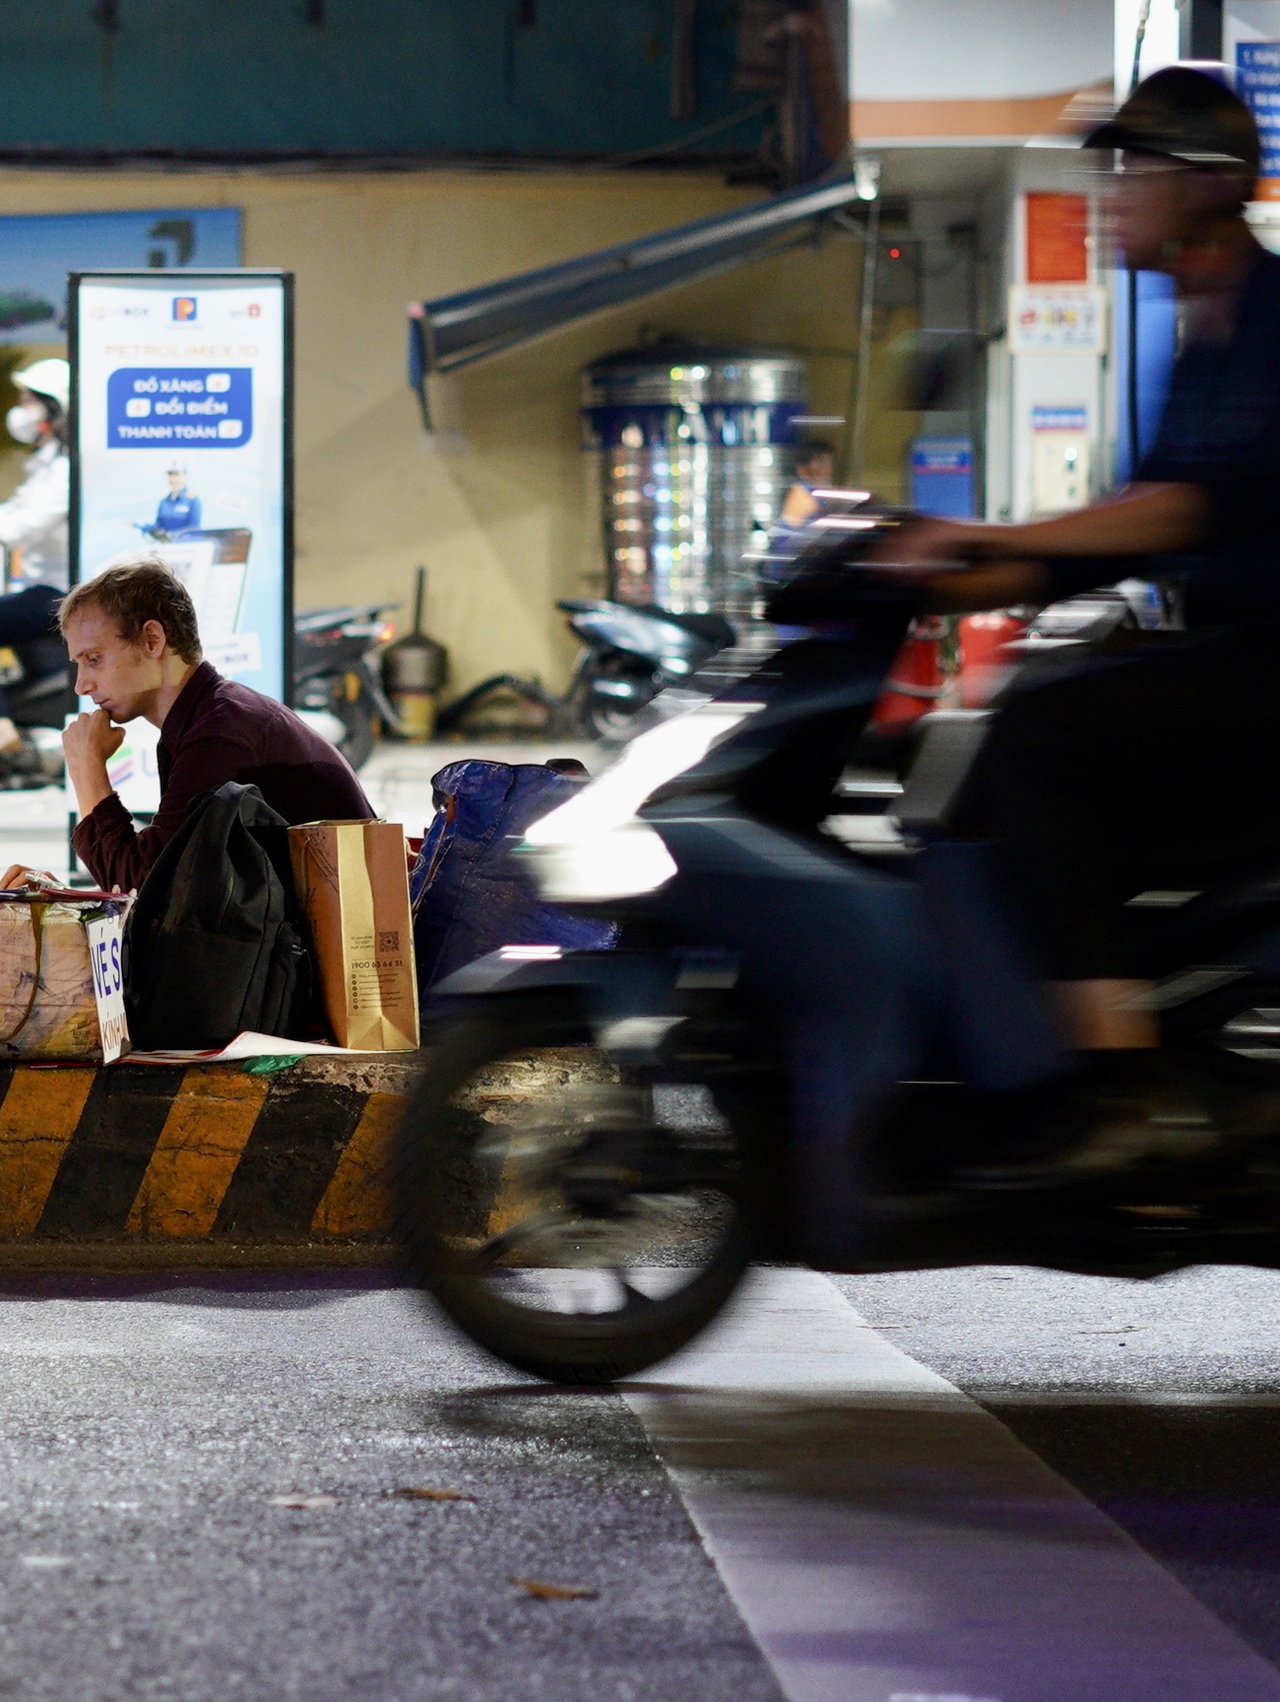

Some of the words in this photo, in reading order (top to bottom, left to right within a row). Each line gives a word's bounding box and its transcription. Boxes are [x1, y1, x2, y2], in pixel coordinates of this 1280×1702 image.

[105, 344, 232, 358] PETROLIMEX
[118, 425, 172, 439] THANH
[91, 926, 112, 998] VÉ
[351, 961, 370, 969] 1900
[102, 1012, 122, 1051] KÍNH
